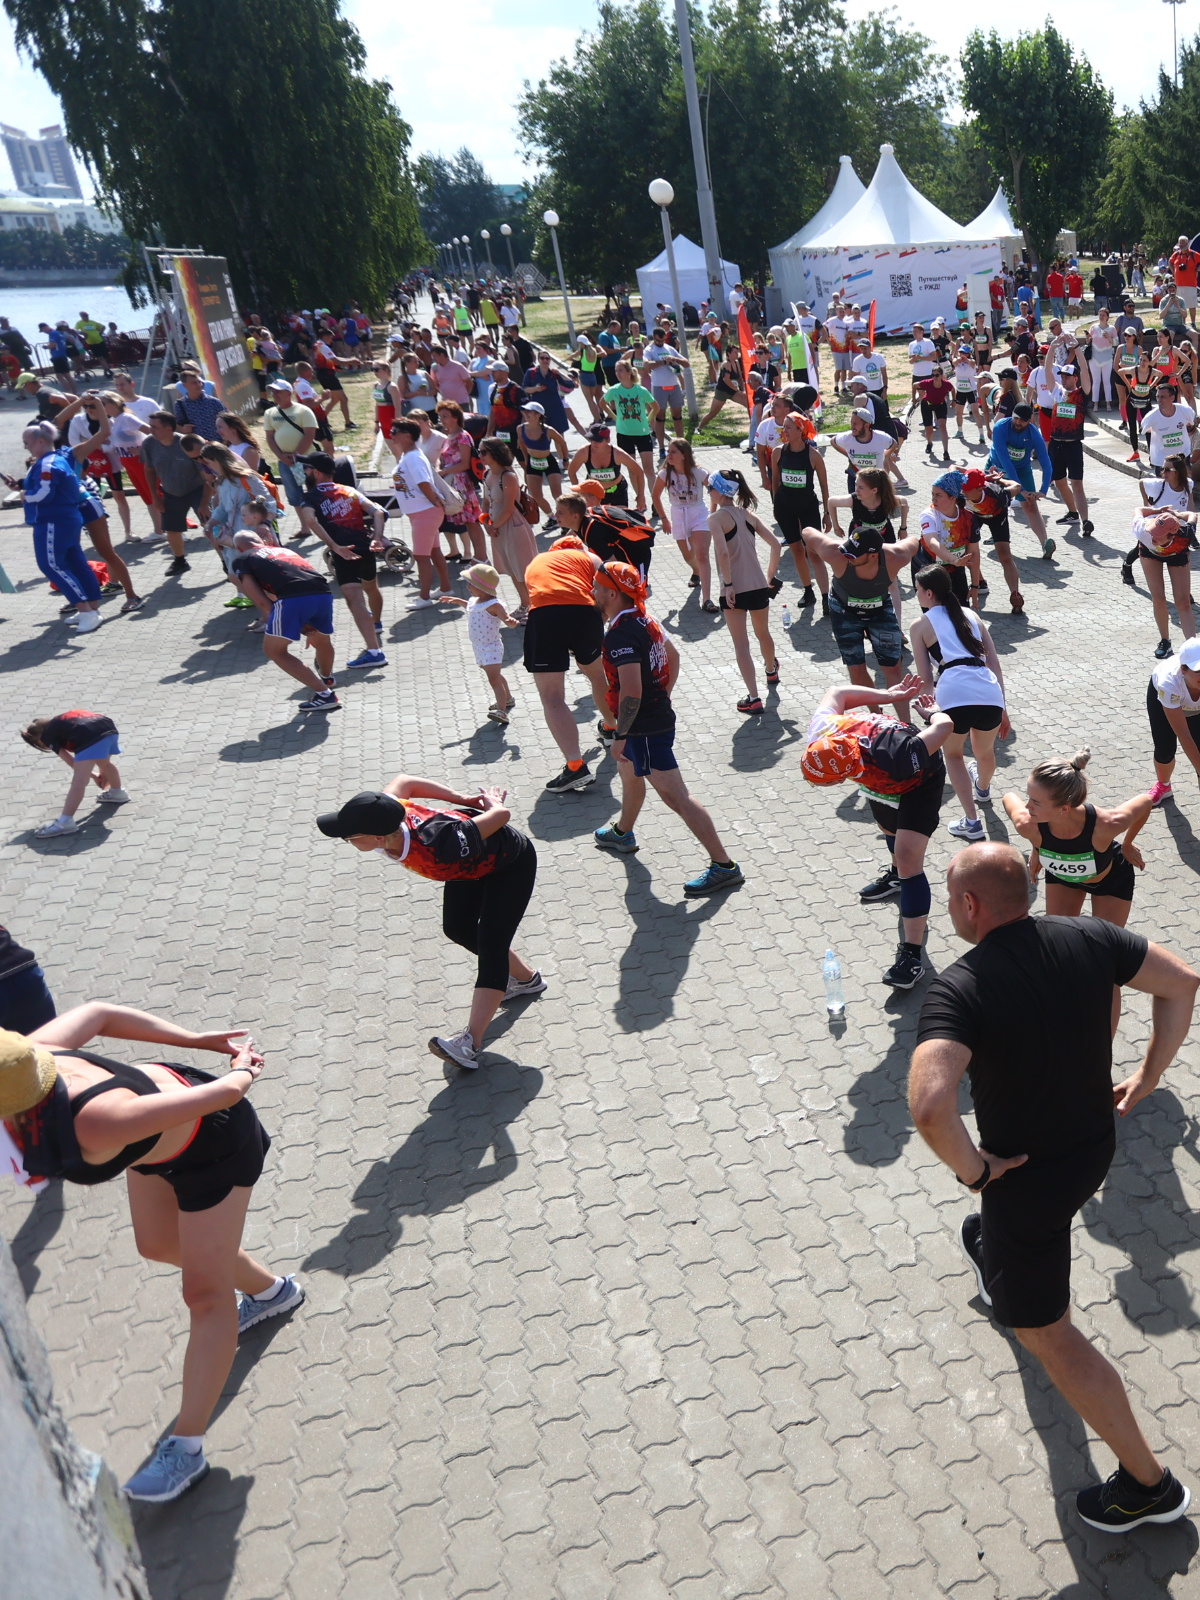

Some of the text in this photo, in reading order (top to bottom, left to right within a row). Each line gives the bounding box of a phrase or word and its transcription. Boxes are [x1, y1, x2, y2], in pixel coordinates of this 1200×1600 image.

[918, 275, 958, 283] Путешествуй
[785, 475, 803, 483] 5304
[1048, 861, 1087, 874] 4459
